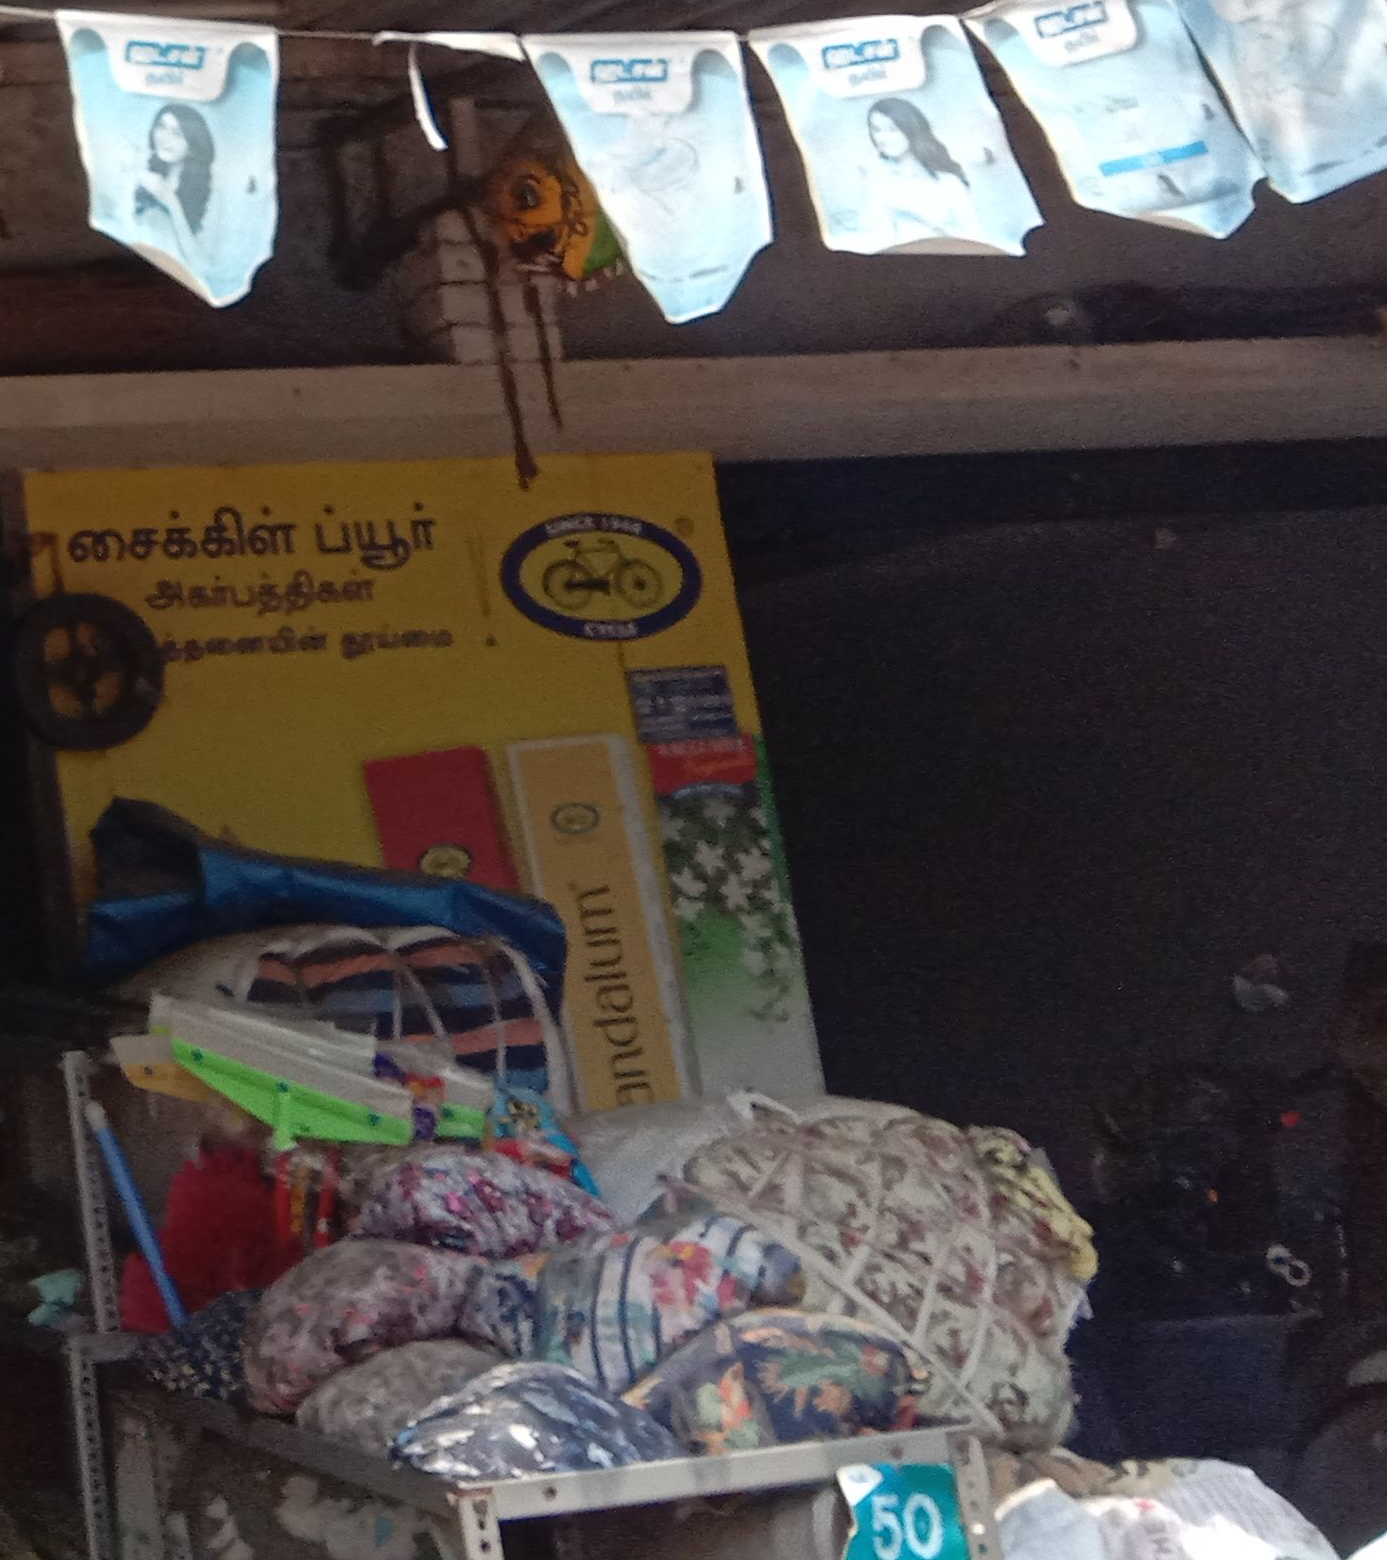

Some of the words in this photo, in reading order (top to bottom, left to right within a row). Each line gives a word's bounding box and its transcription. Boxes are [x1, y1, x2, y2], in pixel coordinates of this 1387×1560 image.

[67, 506, 296, 563] சைக்கிள்
[314, 502, 437, 569] ப்யூர்
[575, 883, 655, 1106] andalum
[871, 1493, 945, 1560] 50
